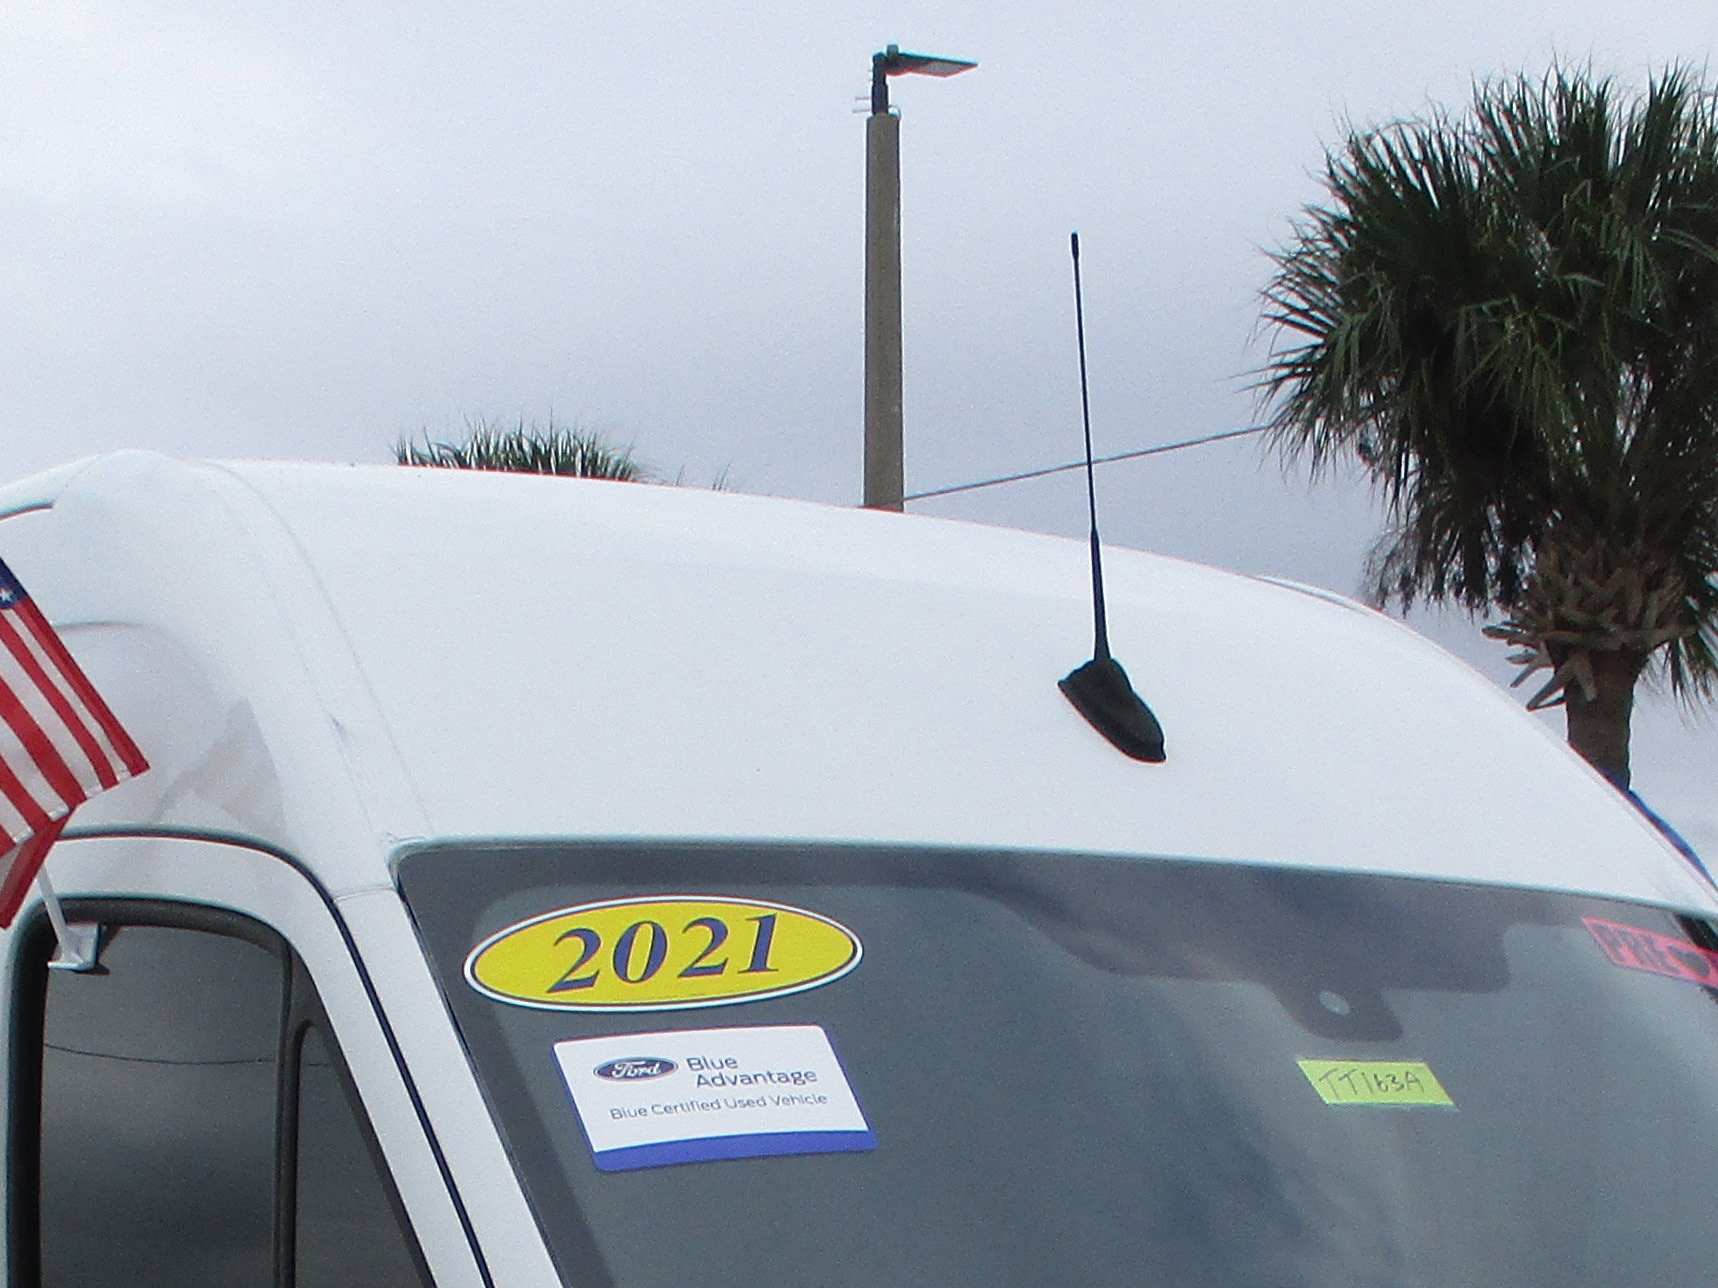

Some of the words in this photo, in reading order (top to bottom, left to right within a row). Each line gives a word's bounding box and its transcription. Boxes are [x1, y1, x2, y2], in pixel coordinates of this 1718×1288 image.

[545, 913, 781, 994] 2021
[610, 1060, 662, 1079] Ford
[685, 1055, 739, 1072] Blue
[695, 1068, 819, 1089] Advantage
[609, 1105, 648, 1120] Blue
[650, 1098, 722, 1116] Certified
[722, 1094, 768, 1110] Used
[769, 1092, 828, 1107] Vehicle
